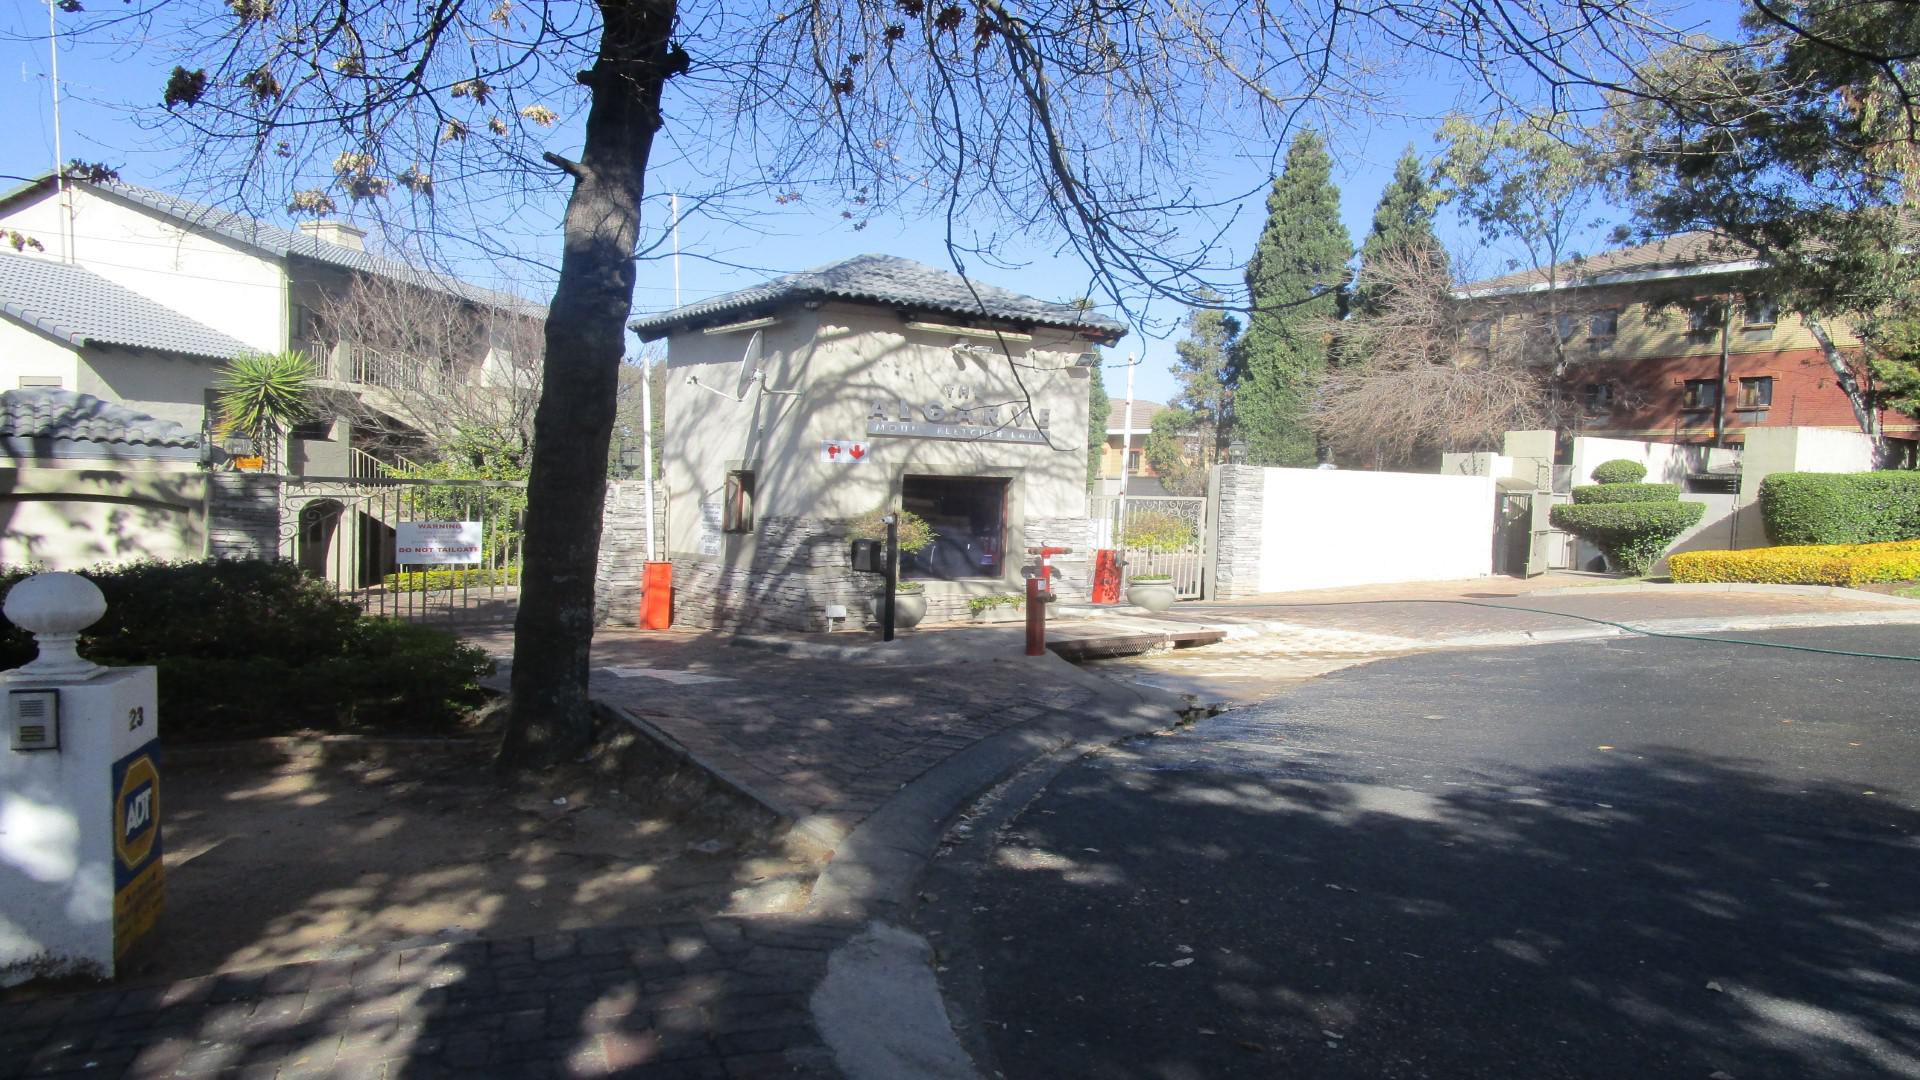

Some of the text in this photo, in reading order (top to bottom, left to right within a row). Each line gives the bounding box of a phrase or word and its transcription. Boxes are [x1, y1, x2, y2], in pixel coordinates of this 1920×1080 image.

[867, 400, 1050, 430] ALGARVE
[875, 423, 922, 433] MOUN
[128, 706, 144, 732] 23
[126, 786, 153, 836] ADT
